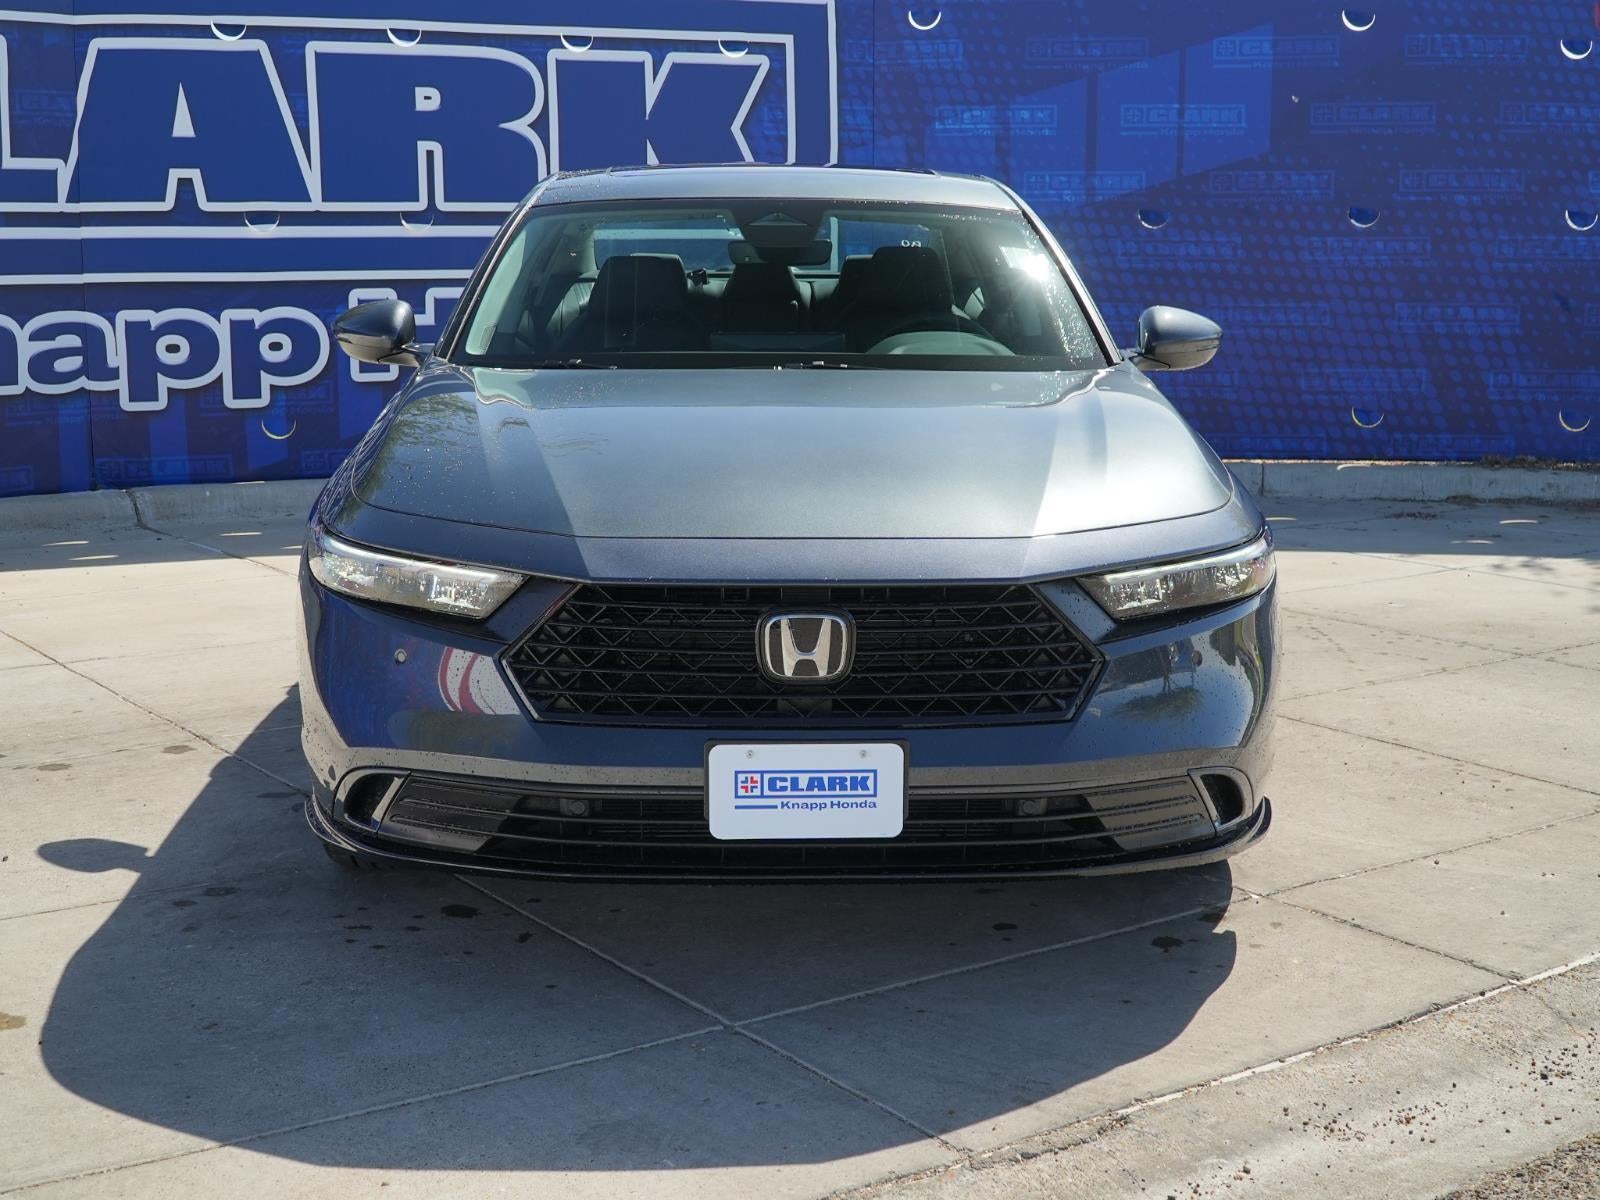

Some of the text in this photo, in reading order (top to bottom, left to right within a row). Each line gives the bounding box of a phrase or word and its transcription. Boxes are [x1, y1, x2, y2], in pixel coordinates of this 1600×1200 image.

[0, 305, 331, 411] app
[767, 775, 871, 793] CLARK
[780, 799, 877, 811] Knapp Honda
